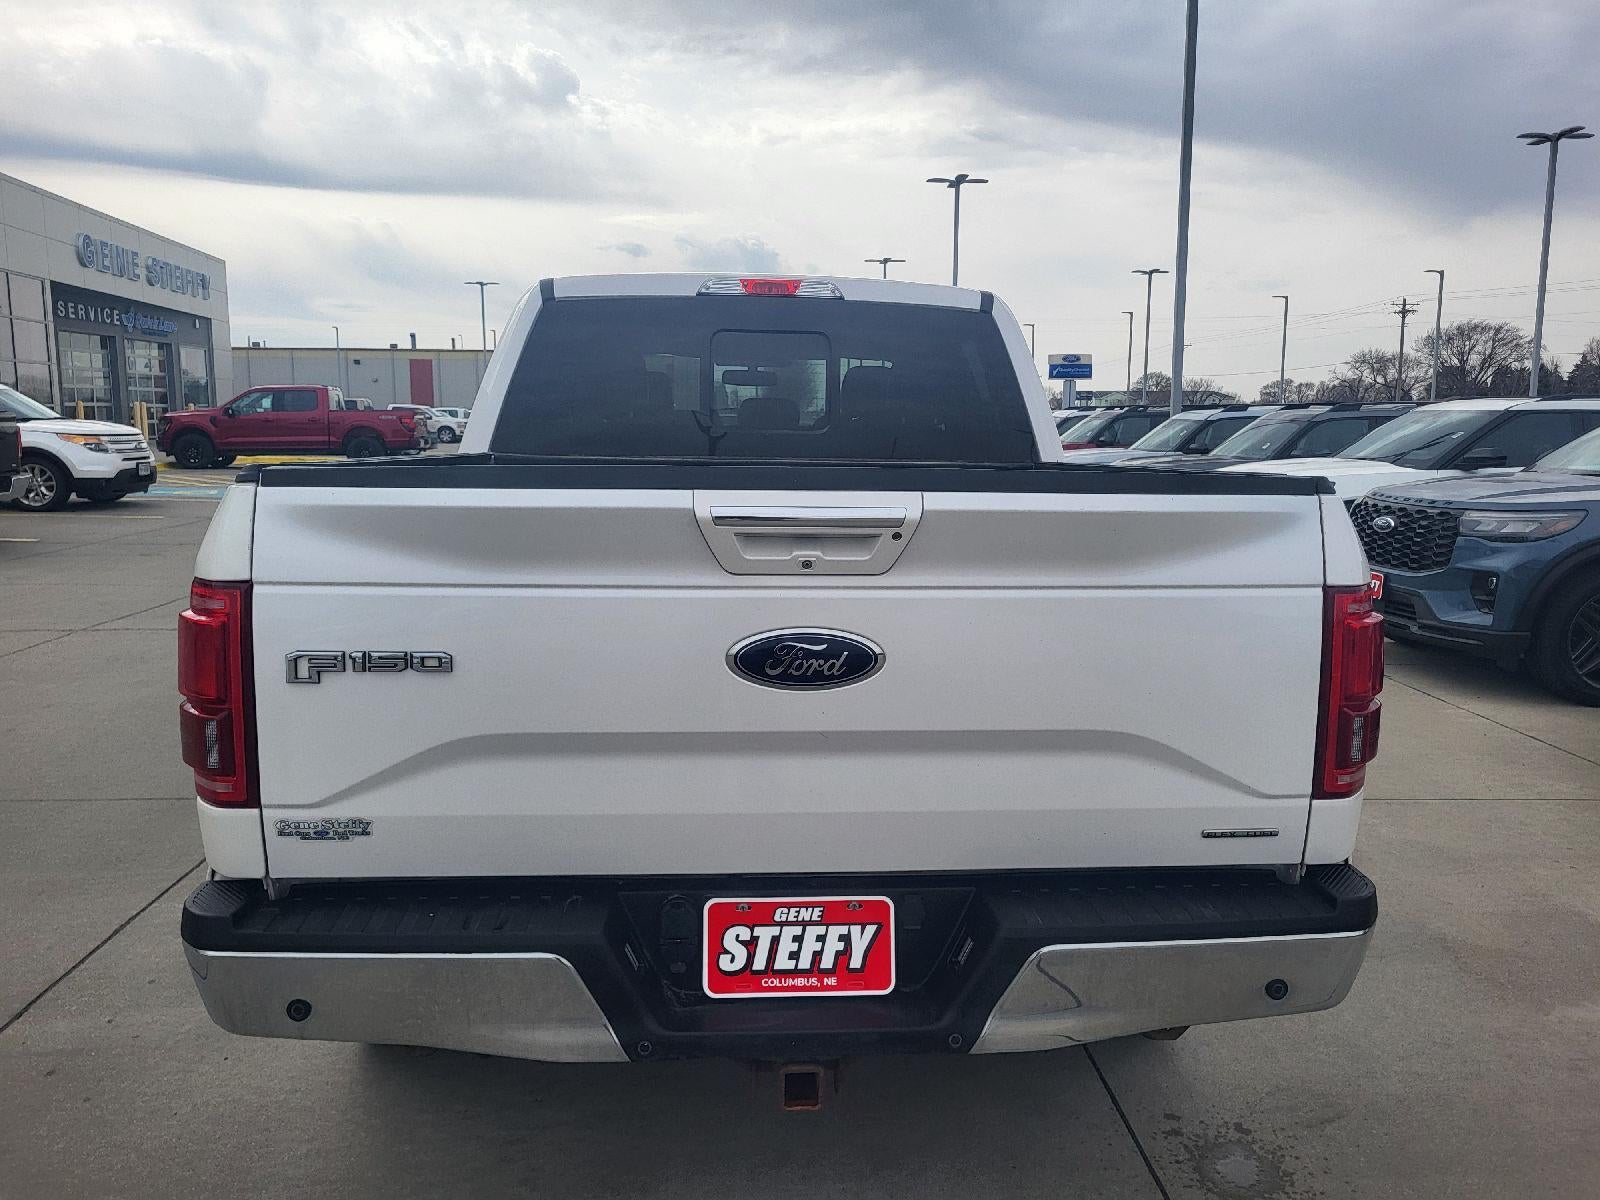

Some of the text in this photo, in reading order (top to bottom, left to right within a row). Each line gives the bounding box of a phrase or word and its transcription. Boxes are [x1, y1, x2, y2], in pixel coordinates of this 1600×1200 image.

[76, 232, 211, 300] GENE STEFFY
[57, 300, 121, 325] SERVICE
[765, 642, 849, 676] Ford
[274, 819, 320, 831] Gene
[773, 906, 825, 923] GENE
[717, 924, 883, 976] STEFFY
[761, 977, 838, 988] COLUMBUS, NE
